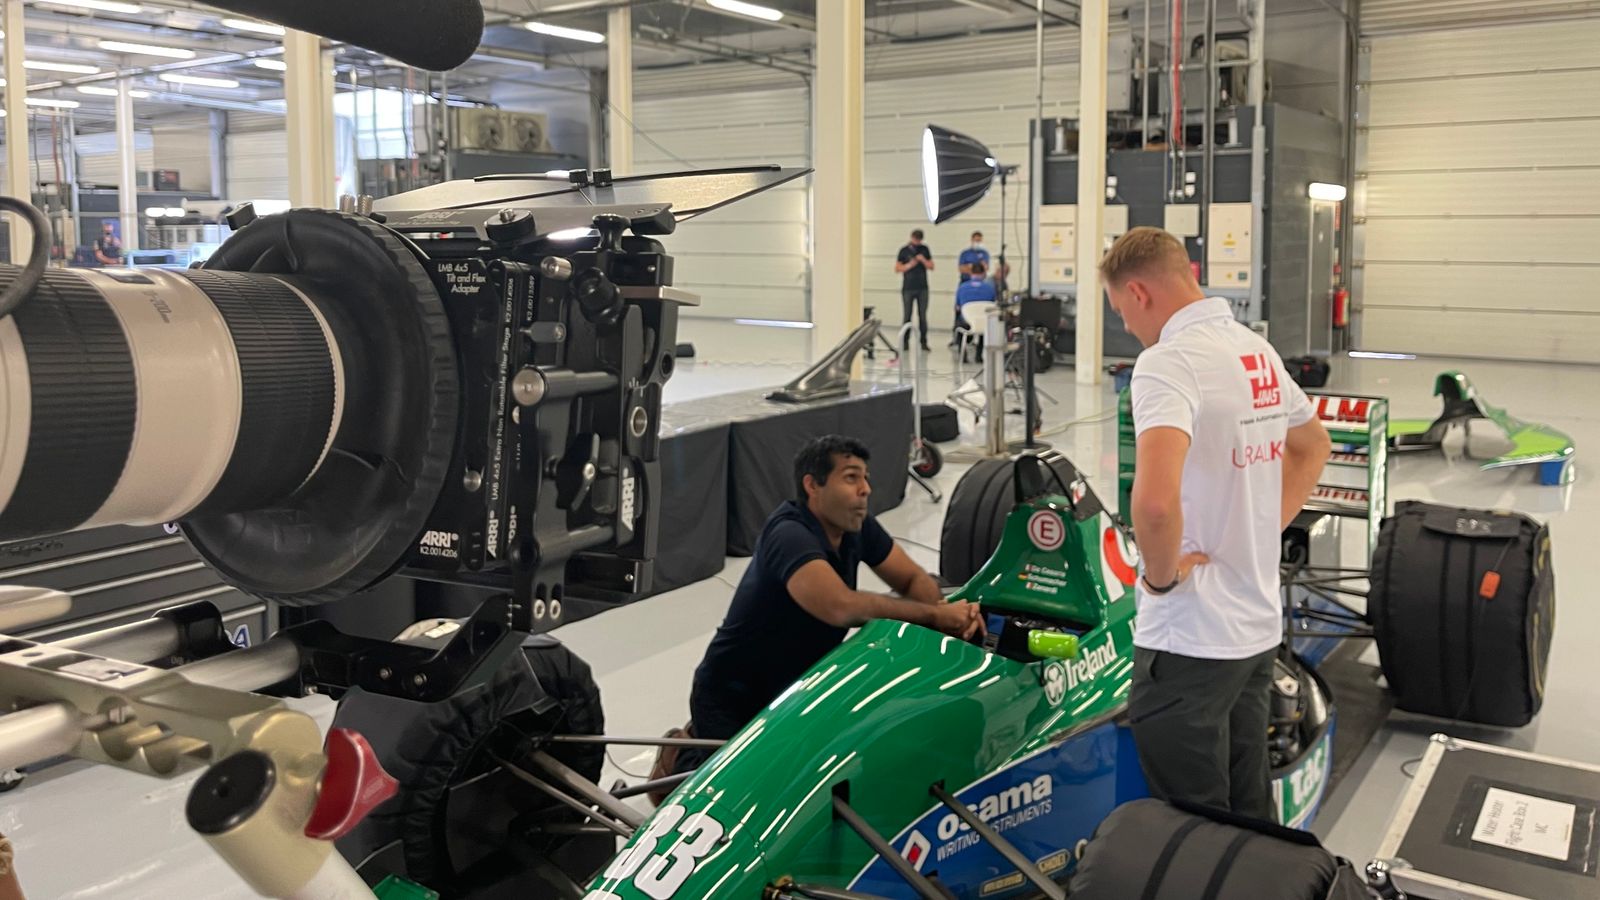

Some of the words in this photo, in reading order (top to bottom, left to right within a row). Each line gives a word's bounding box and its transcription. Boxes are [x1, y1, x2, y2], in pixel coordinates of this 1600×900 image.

[438, 263, 453, 272] LMB
[454, 263, 469, 272] 4x5
[446, 273, 456, 283] Tilt
[456, 273, 471, 283] and
[472, 273, 486, 283] Flex
[451, 284, 480, 295] Adapter
[502, 327, 511, 351] Stage
[500, 353, 508, 374] Filter
[1311, 397, 1369, 423] LM
[496, 418, 504, 437] Non
[493, 463, 501, 479] 4x5
[491, 482, 500, 500] LMB
[622, 476, 635, 531] ARRI
[420, 530, 451, 548] ARRI
[487, 519, 499, 558] ARRI
[1040, 520, 1054, 540] E
[1063, 631, 1118, 691] Ireland
[990, 799, 1052, 834] STRUMENTS
[602, 803, 725, 900] 33
[937, 831, 981, 862] WRITING
